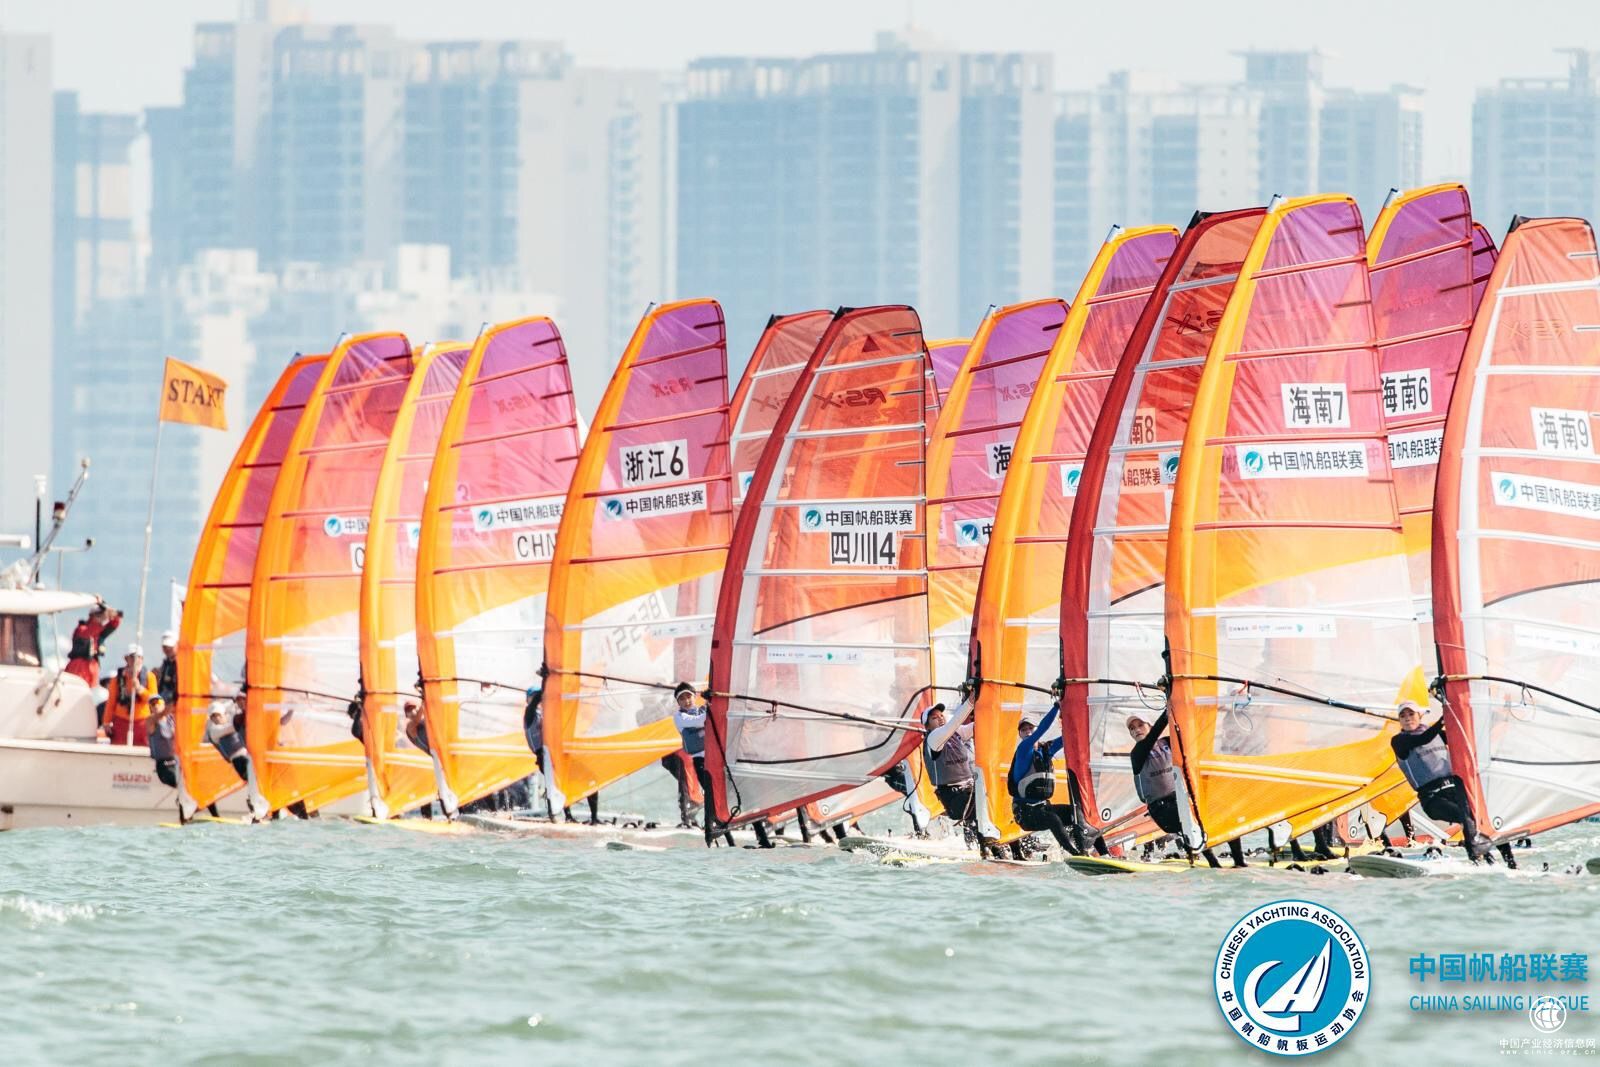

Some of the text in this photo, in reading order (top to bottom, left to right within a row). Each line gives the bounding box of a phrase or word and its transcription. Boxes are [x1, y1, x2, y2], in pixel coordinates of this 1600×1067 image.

[168, 378, 224, 408] START
[1290, 386, 1344, 424] 海南7
[1381, 376, 1429, 412] 海南6
[1539, 411, 1589, 450] 海南9
[625, 446, 684, 482] 浙江6
[1268, 450, 1364, 471] 中国帆船联赛
[626, 490, 704, 514] 中国帆船联赛
[1521, 482, 1600, 512] 中国帆船联赛
[826, 509, 913, 526] 中国帆船联赛
[831, 531, 896, 565] 四川14
